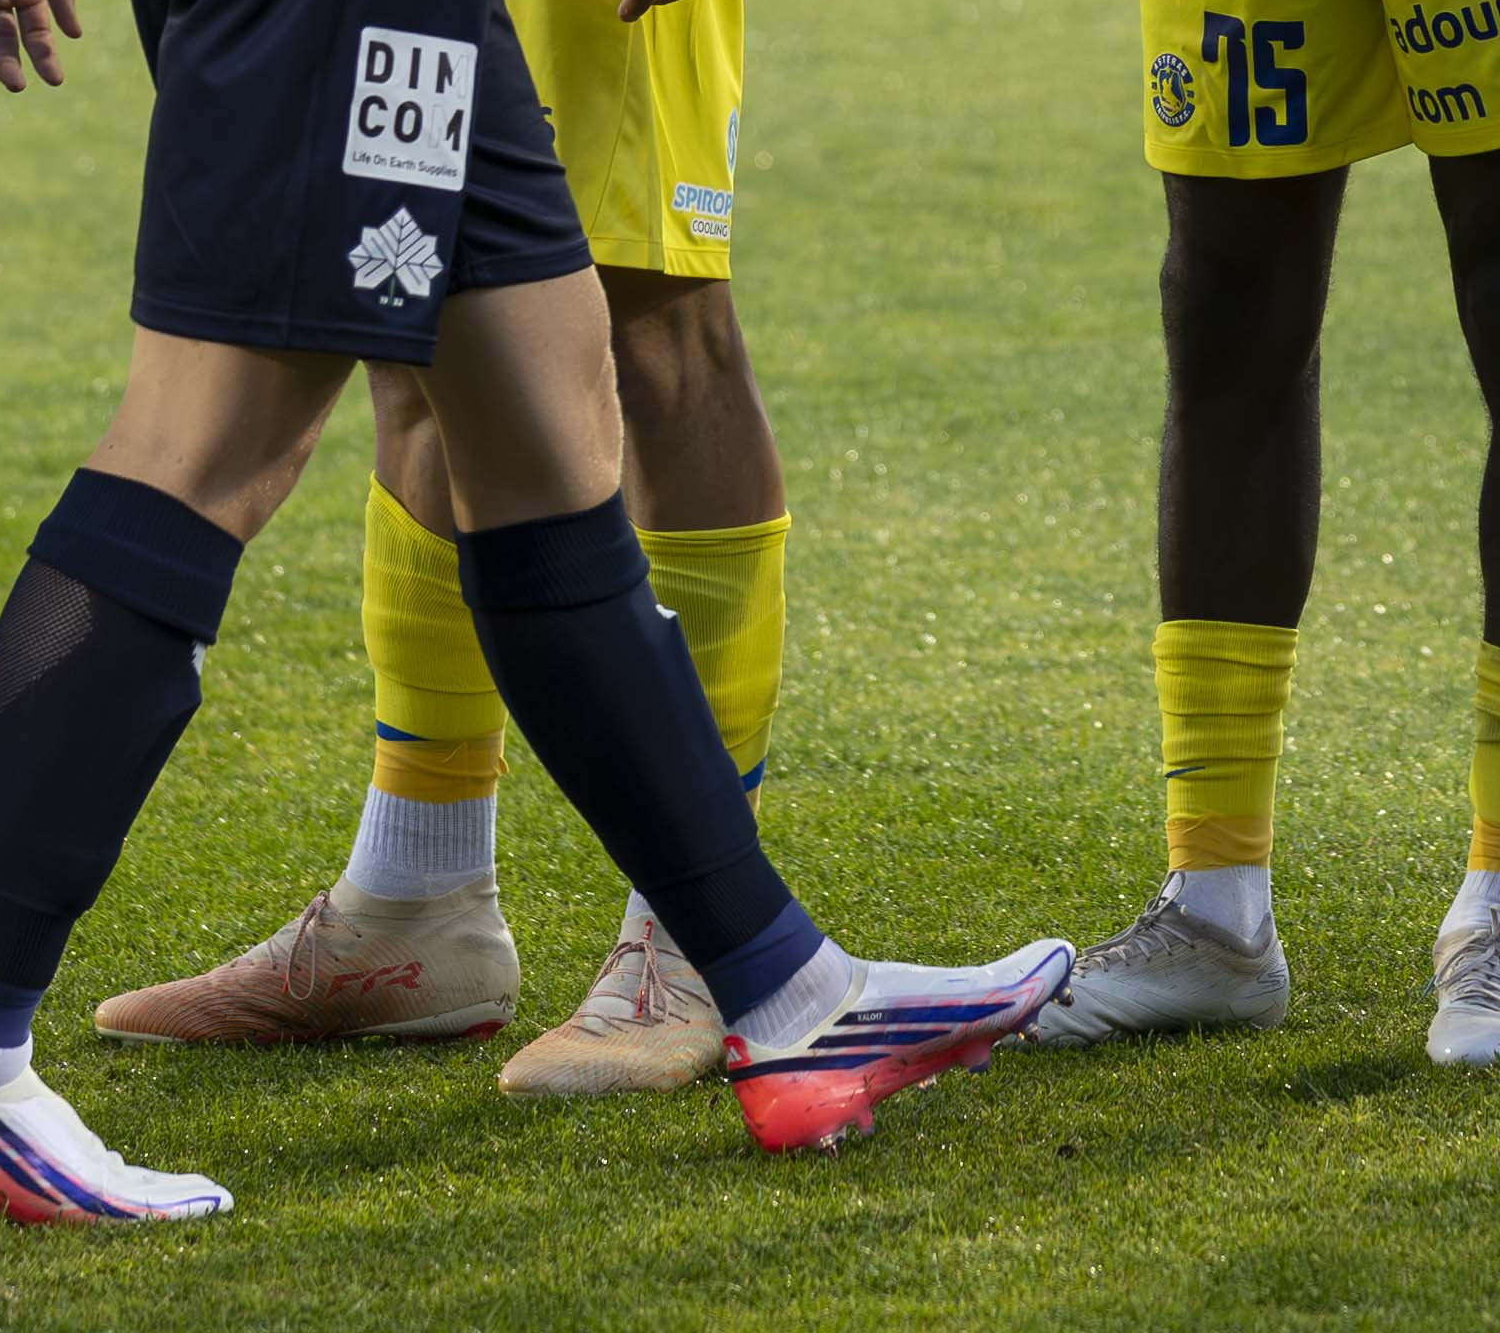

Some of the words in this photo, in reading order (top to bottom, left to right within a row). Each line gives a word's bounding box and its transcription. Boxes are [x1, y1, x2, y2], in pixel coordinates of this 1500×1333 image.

[1202, 11, 1308, 148] 75
[352, 151, 371, 164] Life
[373, 153, 387, 166] On
[389, 156, 416, 170] Earth
[418, 161, 458, 177] Supplies
[692, 219, 728, 237] COOLING
